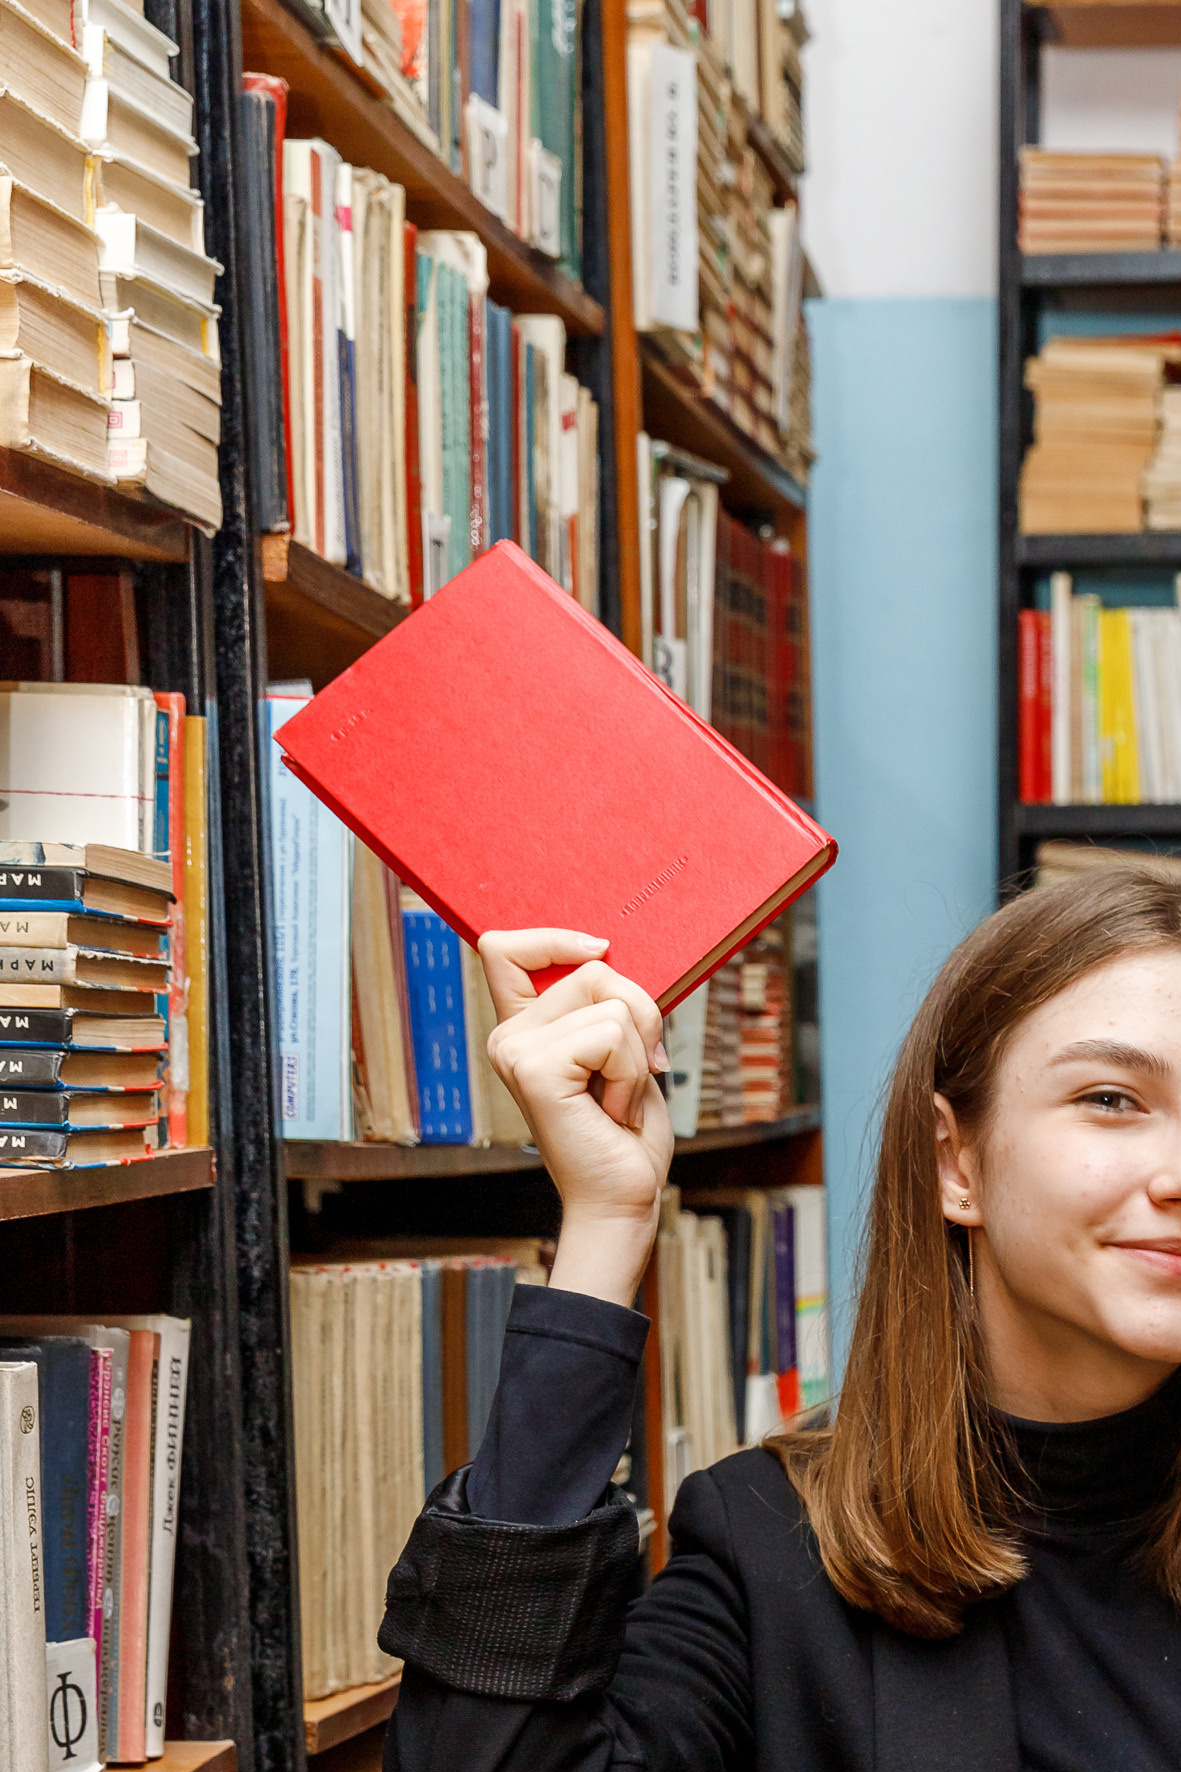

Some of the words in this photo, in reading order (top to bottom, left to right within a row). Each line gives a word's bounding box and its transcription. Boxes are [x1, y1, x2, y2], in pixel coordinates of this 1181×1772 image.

[167, 1355, 183, 1471] ФИННЕЙ
[25, 1475, 37, 1532] УЭЛЛС
[29, 1534, 41, 1614] ГЕРБЕРТ
[50, 1671, 87, 1761] Ф
